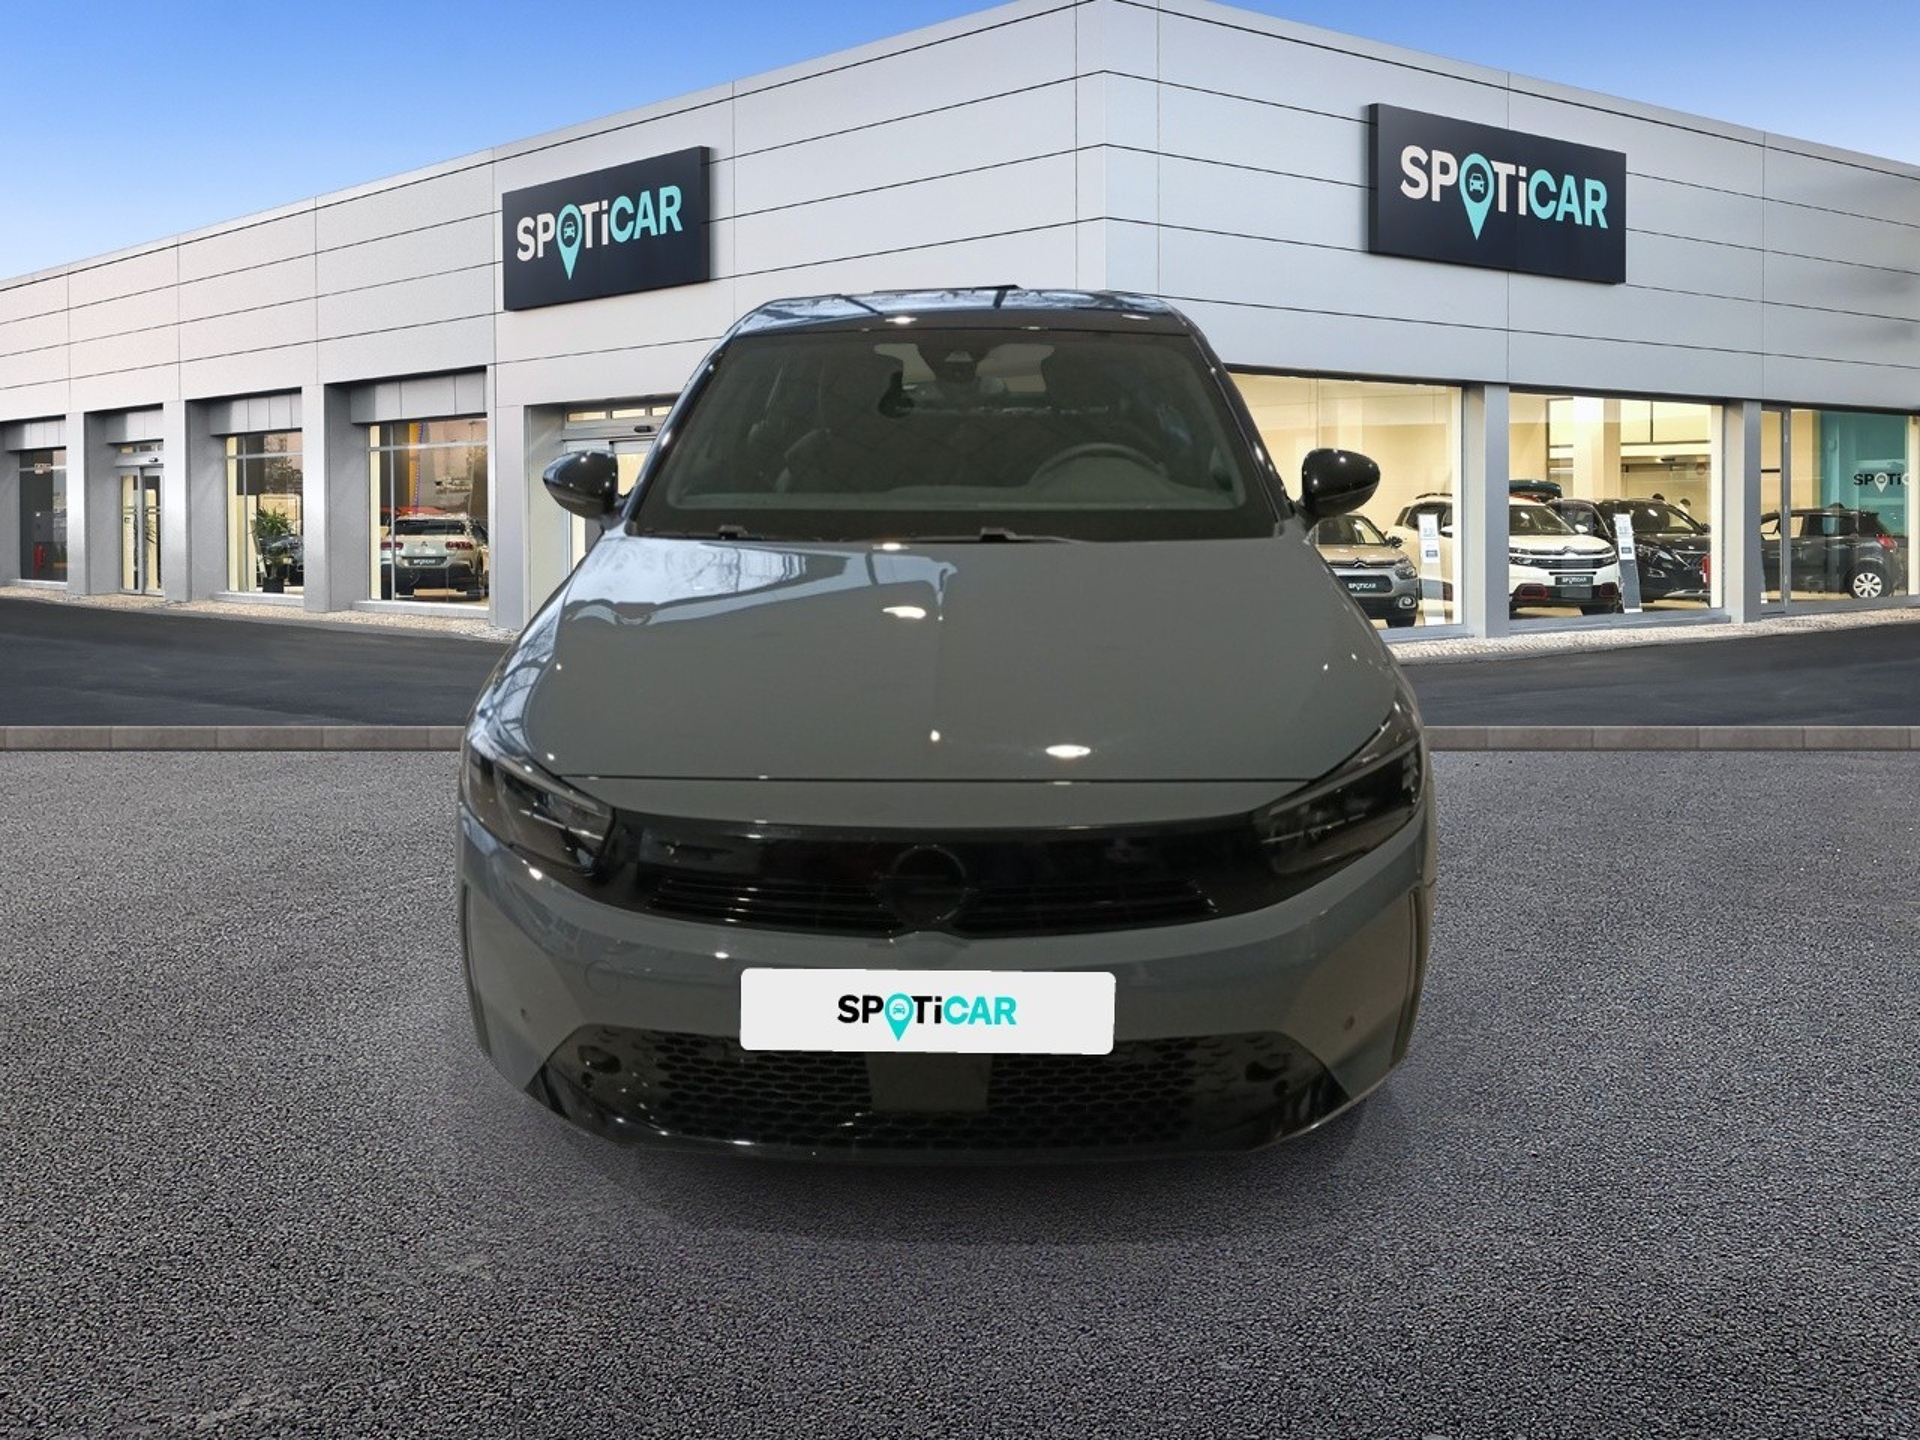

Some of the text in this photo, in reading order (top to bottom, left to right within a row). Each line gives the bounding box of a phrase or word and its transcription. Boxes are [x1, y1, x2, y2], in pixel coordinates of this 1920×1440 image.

[516, 185, 683, 280] SPOTiCAR
[1400, 145, 1608, 240] SPOTiCAR
[837, 992, 1017, 1042] SPOTiCAR
